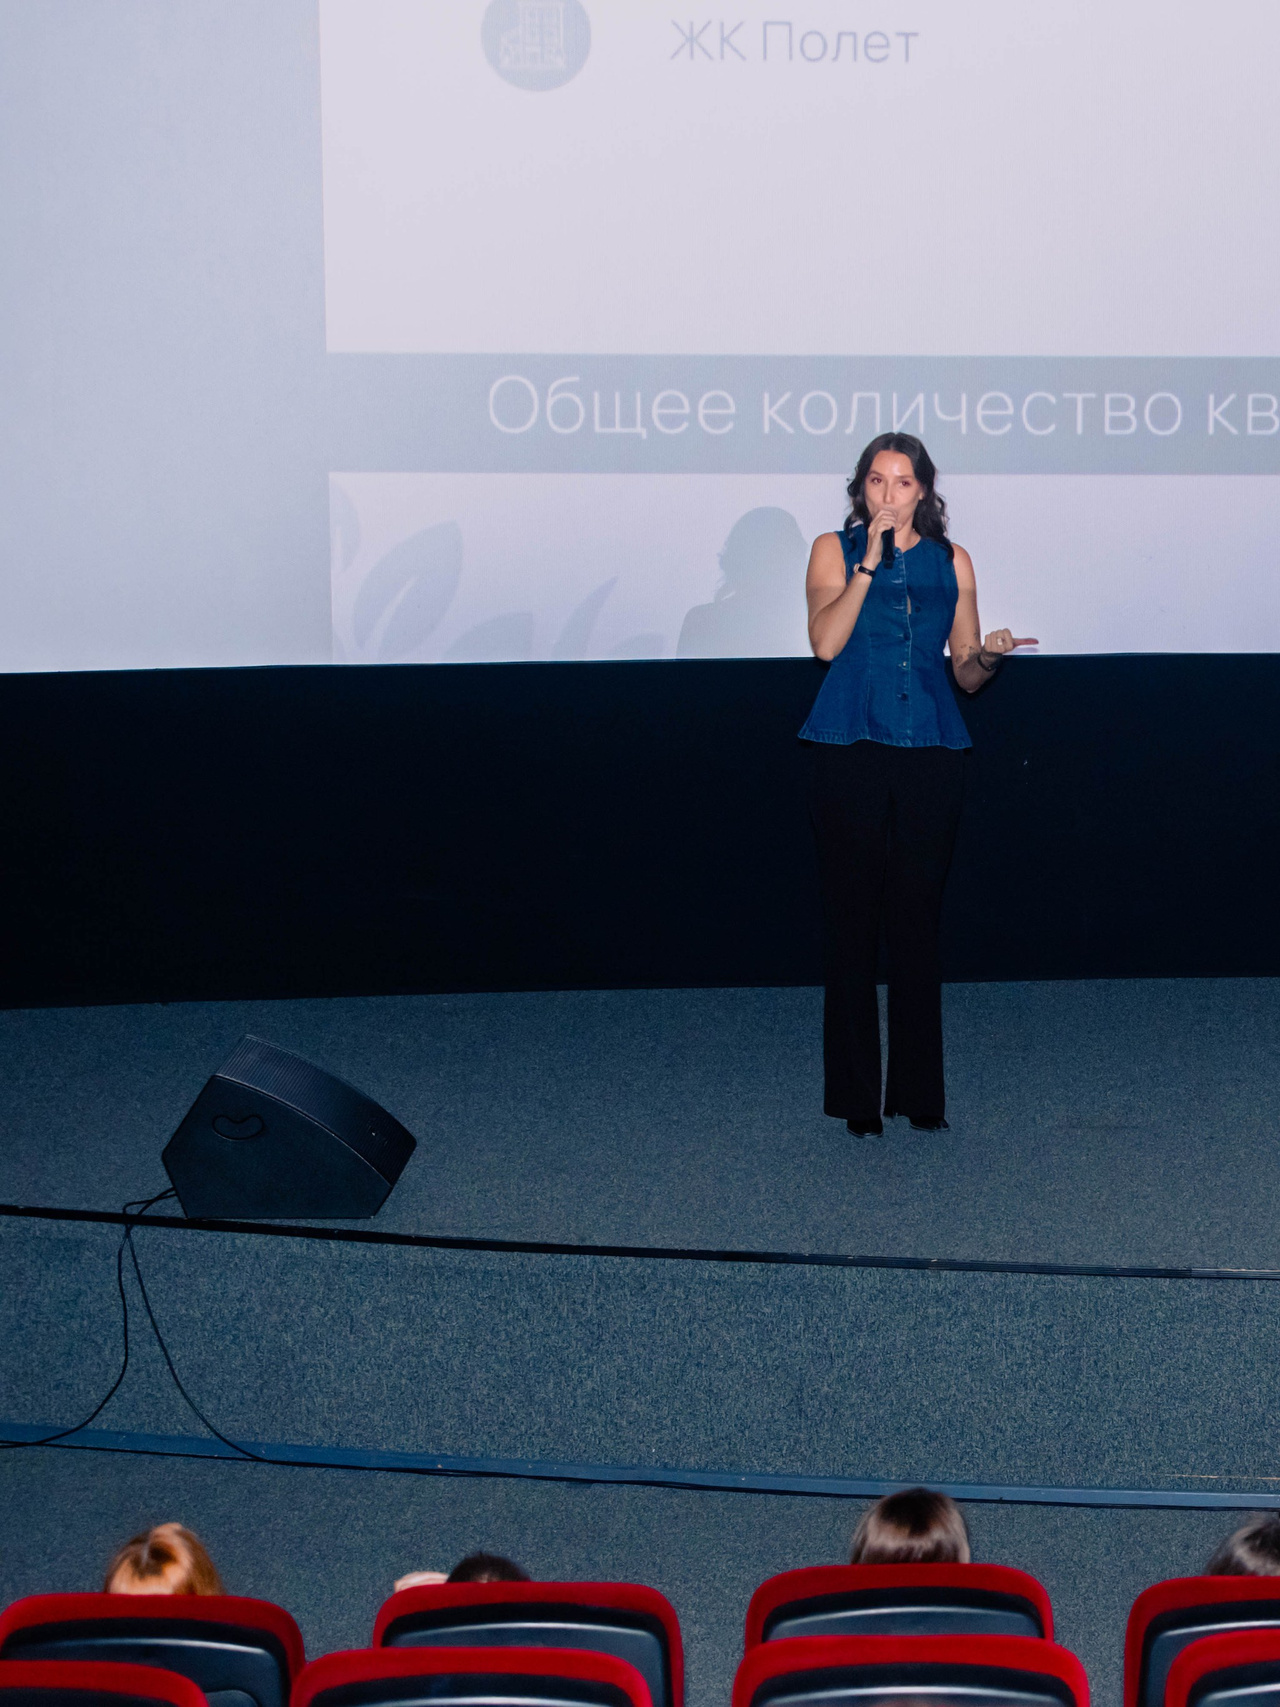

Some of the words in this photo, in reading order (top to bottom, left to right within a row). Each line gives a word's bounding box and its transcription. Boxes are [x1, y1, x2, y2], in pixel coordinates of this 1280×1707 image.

[669, 19, 748, 62] ЖК
[761, 20, 920, 64] Полет
[487, 374, 737, 439] Общее
[762, 390, 1183, 436] количество
